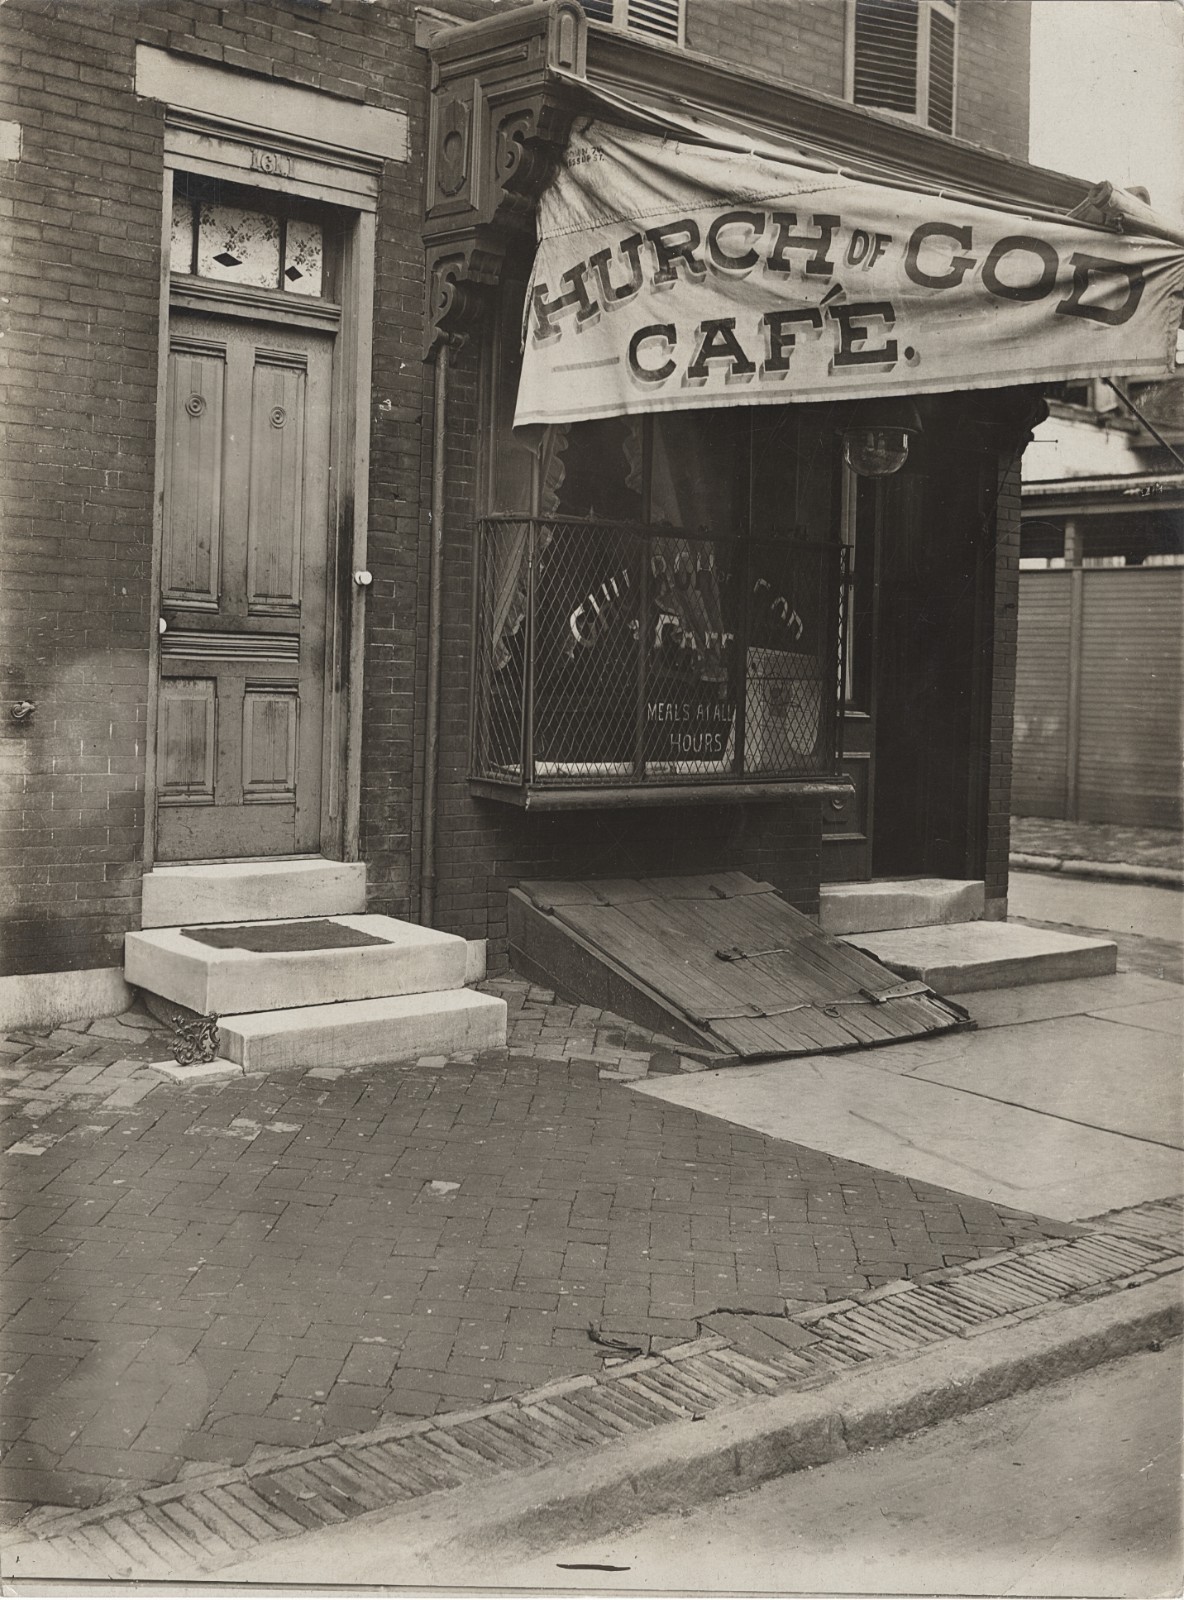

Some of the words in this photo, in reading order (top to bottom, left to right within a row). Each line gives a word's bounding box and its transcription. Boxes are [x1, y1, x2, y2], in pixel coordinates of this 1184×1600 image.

[845, 230, 893, 271] OF
[904, 221, 1147, 327] GOD
[647, 702, 691, 722] MEALS
[713, 703, 733, 722] ALL
[669, 732, 723, 753] HOURS
